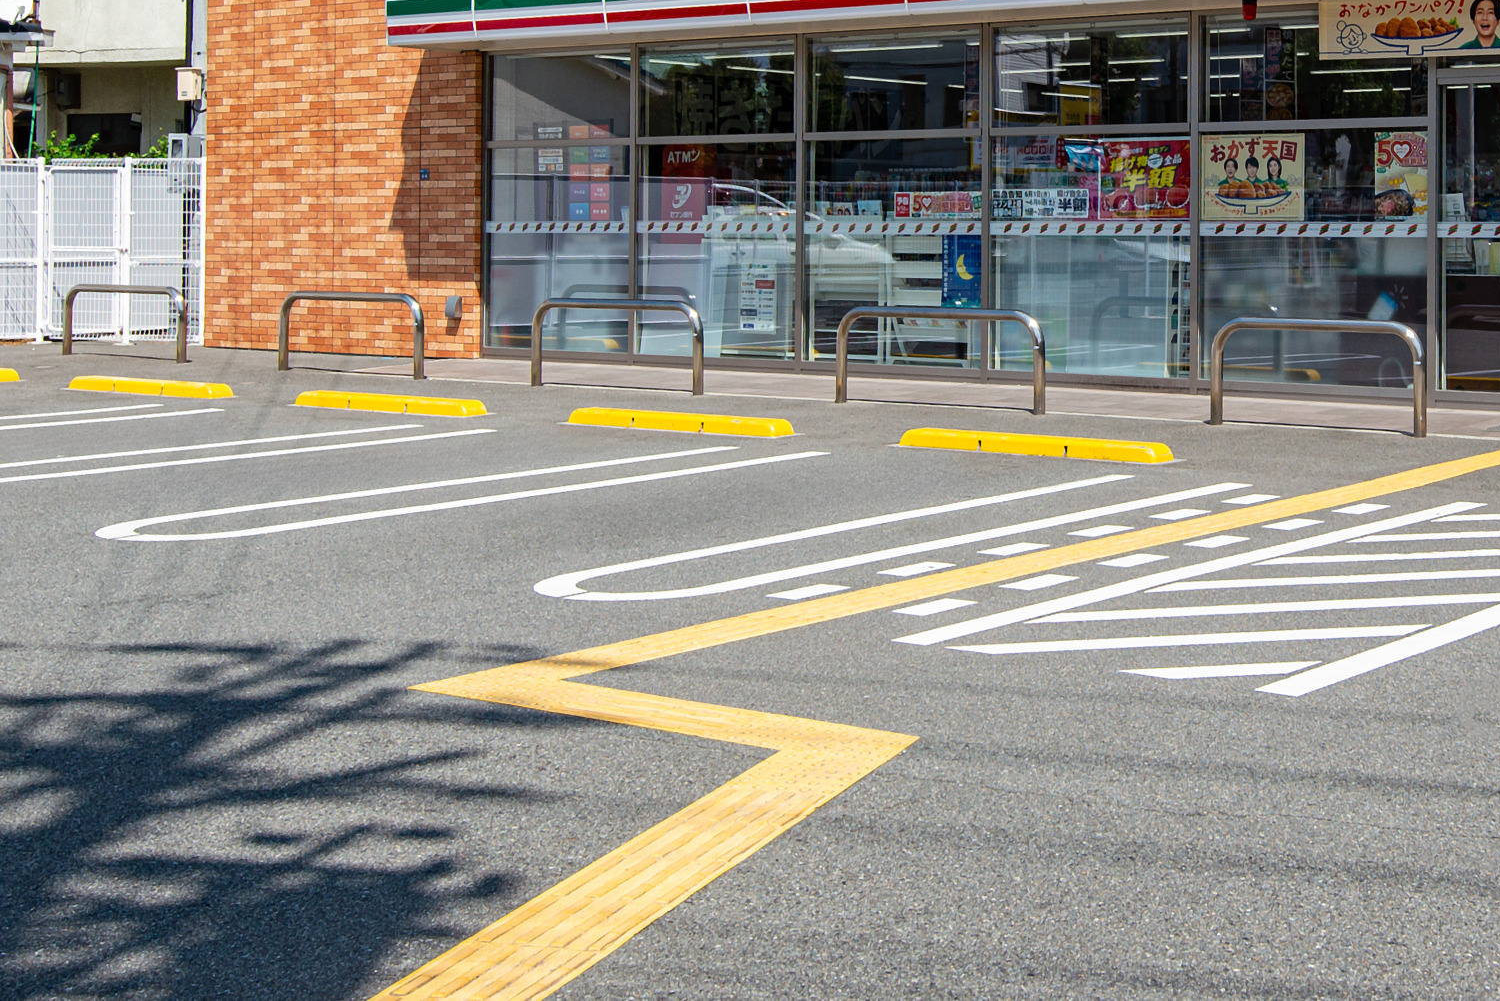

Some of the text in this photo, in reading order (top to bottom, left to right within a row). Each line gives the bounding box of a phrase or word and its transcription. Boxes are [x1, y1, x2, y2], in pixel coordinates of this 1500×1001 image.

[667, 150, 692, 164] ATM
[1164, 153, 1182, 166] 全品
[1210, 136, 1298, 164] おかず天国
[1120, 166, 1176, 193] 半額
